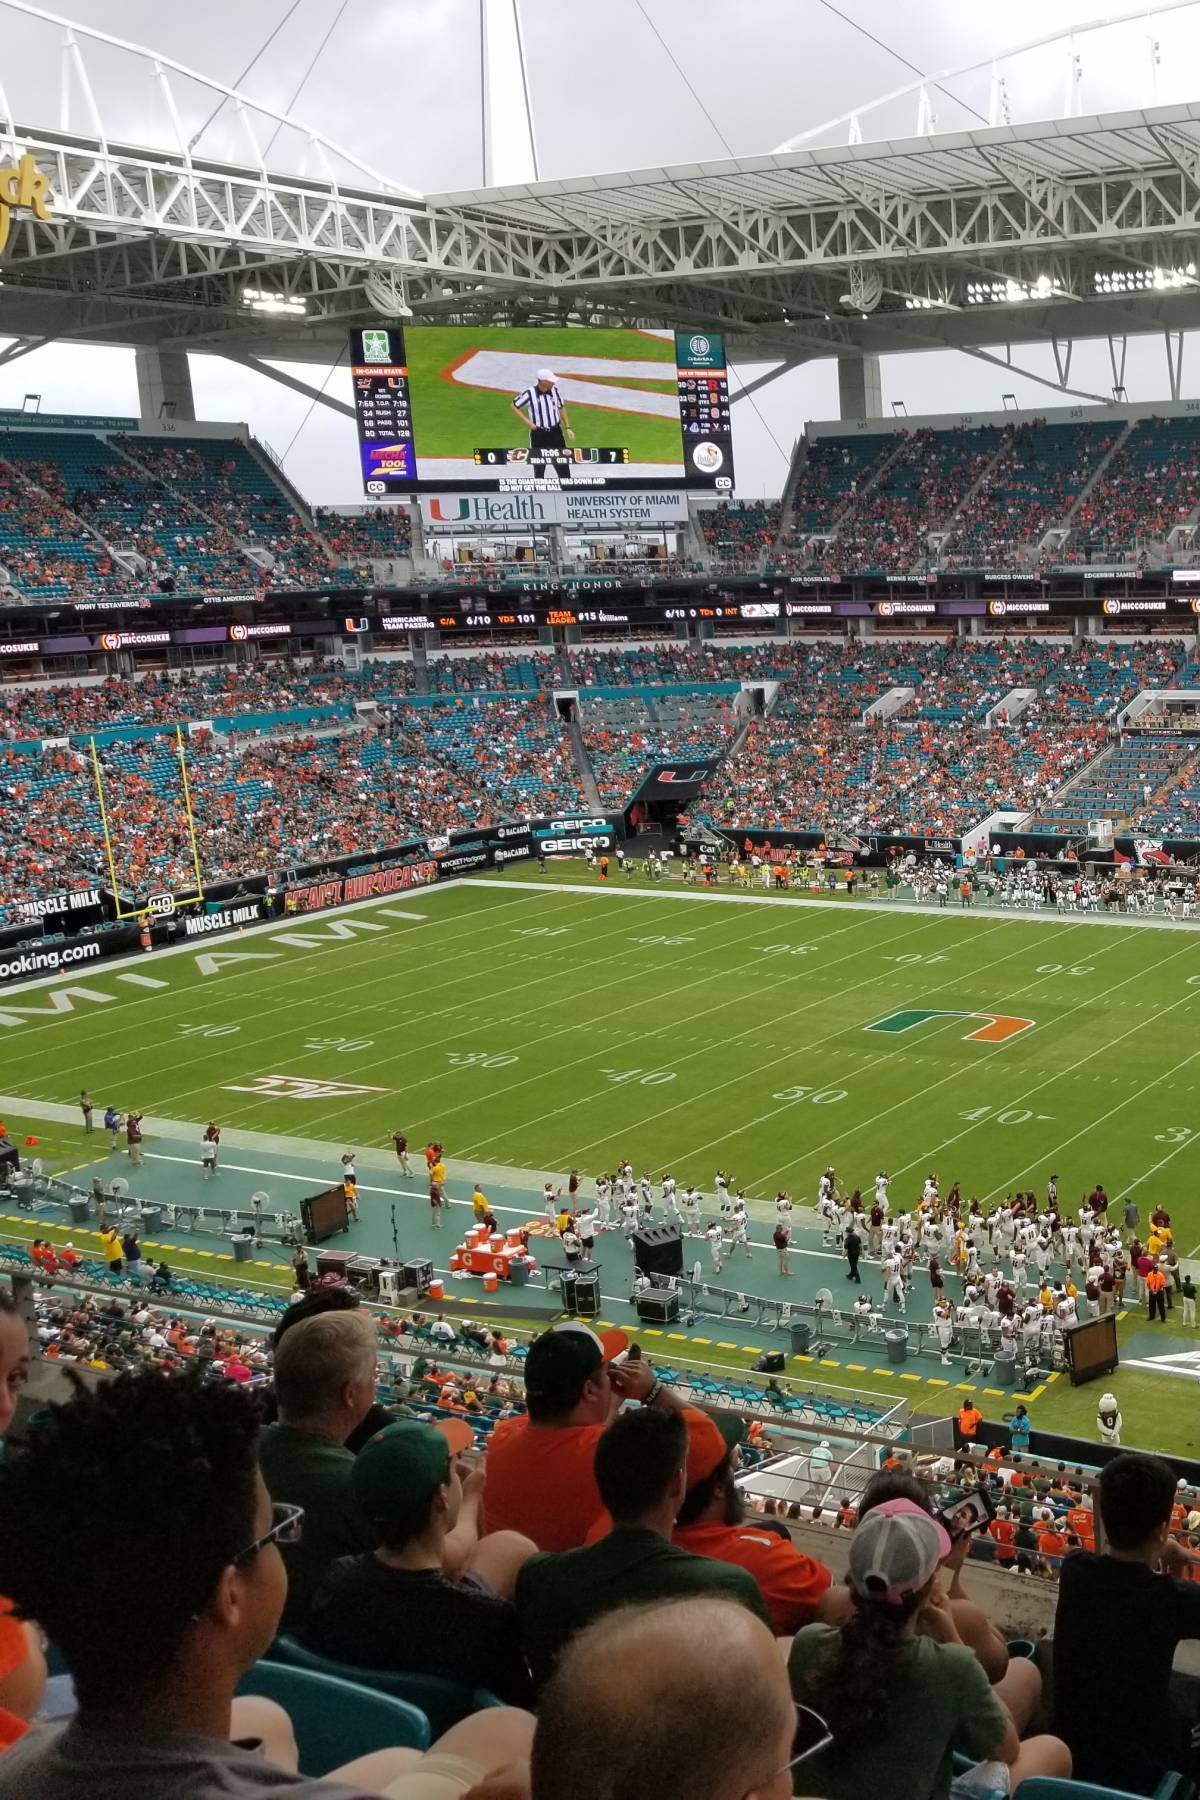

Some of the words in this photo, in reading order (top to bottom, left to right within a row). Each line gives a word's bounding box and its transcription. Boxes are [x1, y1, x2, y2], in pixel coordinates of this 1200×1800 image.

[1070, 410, 1083, 418] 343
[162, 424, 175, 432] 336
[488, 452, 495, 462] 0
[541, 449, 559, 457] 11:06
[610, 452, 616, 462] 7
[381, 460, 406, 468] TOOL
[566, 497, 623, 507] UNIVERSITY
[627, 496, 644, 506] OF
[645, 495, 680, 505] MIAMI
[567, 509, 607, 519] HEALTH
[609, 508, 651, 519] SYSTEM
[523, 582, 558, 592] RING
[572, 580, 622, 590] HONOR
[74, 603, 97, 611] VINNY
[793, 605, 832, 613] MICCOSUKEE
[894, 603, 936, 612] MICCOSUKEE
[1006, 603, 1050, 611] MICCOSUKEE
[1121, 601, 1166, 610] MICCOSUKEE
[579, 612, 596, 620] #15
[665, 609, 685, 618] 6/10
[700, 608, 713, 616] TDs
[716, 608, 722, 616] 0
[725, 607, 738, 615] INT
[383, 616, 427, 624] HURRICANES
[440, 617, 456, 625] C/A
[466, 615, 491, 625] 6/10
[498, 615, 515, 624] YDS
[517, 614, 535, 623] 101
[247, 625, 291, 635] MICCOSUKEE
[383, 622, 403, 630] TEAM
[405, 621, 434, 629] PASSING
[121, 633, 170, 644] MICCOSUKEE
[551, 818, 606, 830] GEICO
[540, 837, 610, 852] GEICO
[18, 893, 68, 918] MUSCLE
[70, 891, 101, 907] MILK
[185, 910, 231, 935] MUSCLE
[233, 905, 259, 923] MILK
[520, 926, 572, 937] 10
[638, 935, 697, 945] 20
[762, 944, 820, 955] 30
[895, 953, 951, 965] 40
[1035, 964, 1096, 976] 50
[180, 1023, 241, 1037] 10
[305, 1037, 375, 1052] 20
[448, 1052, 519, 1068] 30
[605, 1068, 677, 1085] 40
[772, 1086, 848, 1104] 50
[958, 1106, 1033, 1125] 40
[462, 1253, 472, 1265] G
[493, 1259, 503, 1271] G
